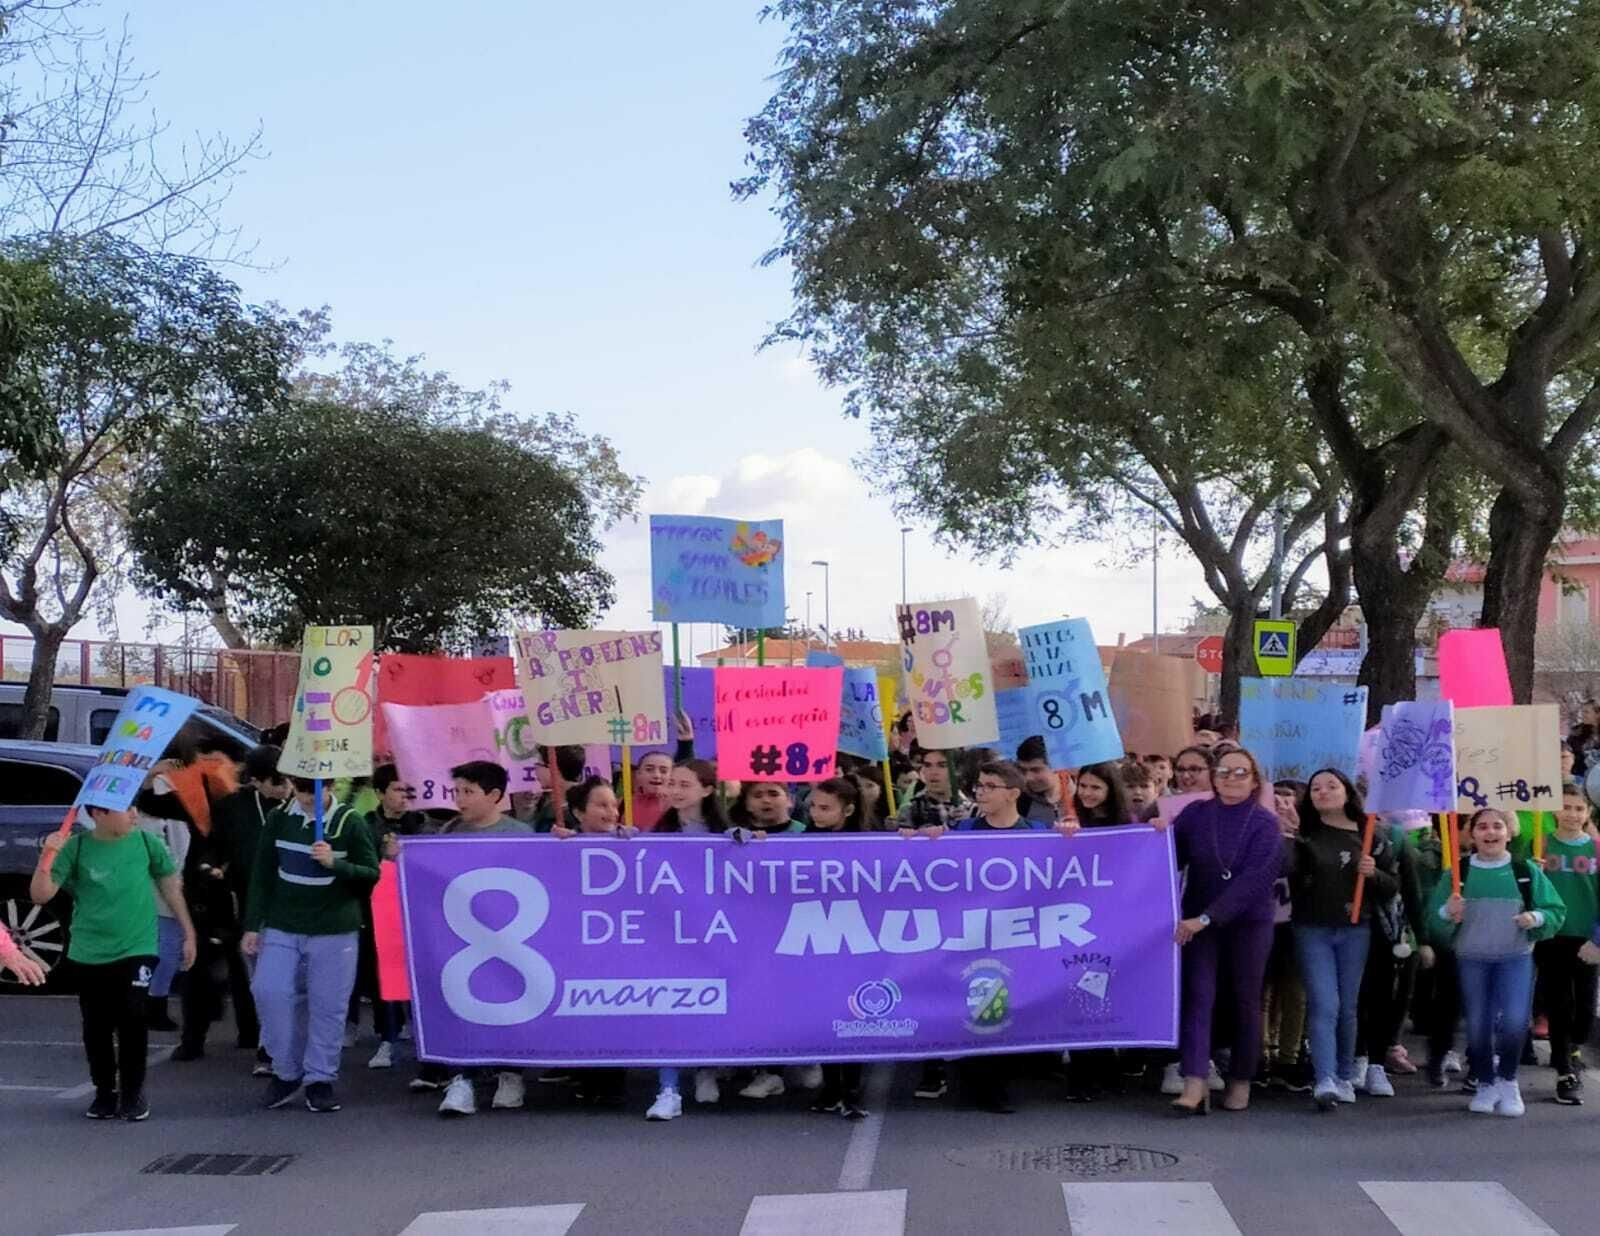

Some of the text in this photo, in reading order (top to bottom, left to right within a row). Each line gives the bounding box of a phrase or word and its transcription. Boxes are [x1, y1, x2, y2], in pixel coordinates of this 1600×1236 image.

[898, 604, 955, 645] #8M
[1200, 650, 1224, 659] STO
[850, 682, 875, 702] LA
[581, 848, 1114, 896] DÍA INTERNACIONAL
[581, 899, 1098, 956] DE LA MUJER
[441, 867, 556, 1026] 8
[1061, 952, 1112, 970] AMPA
[569, 984, 721, 1009] marzo
